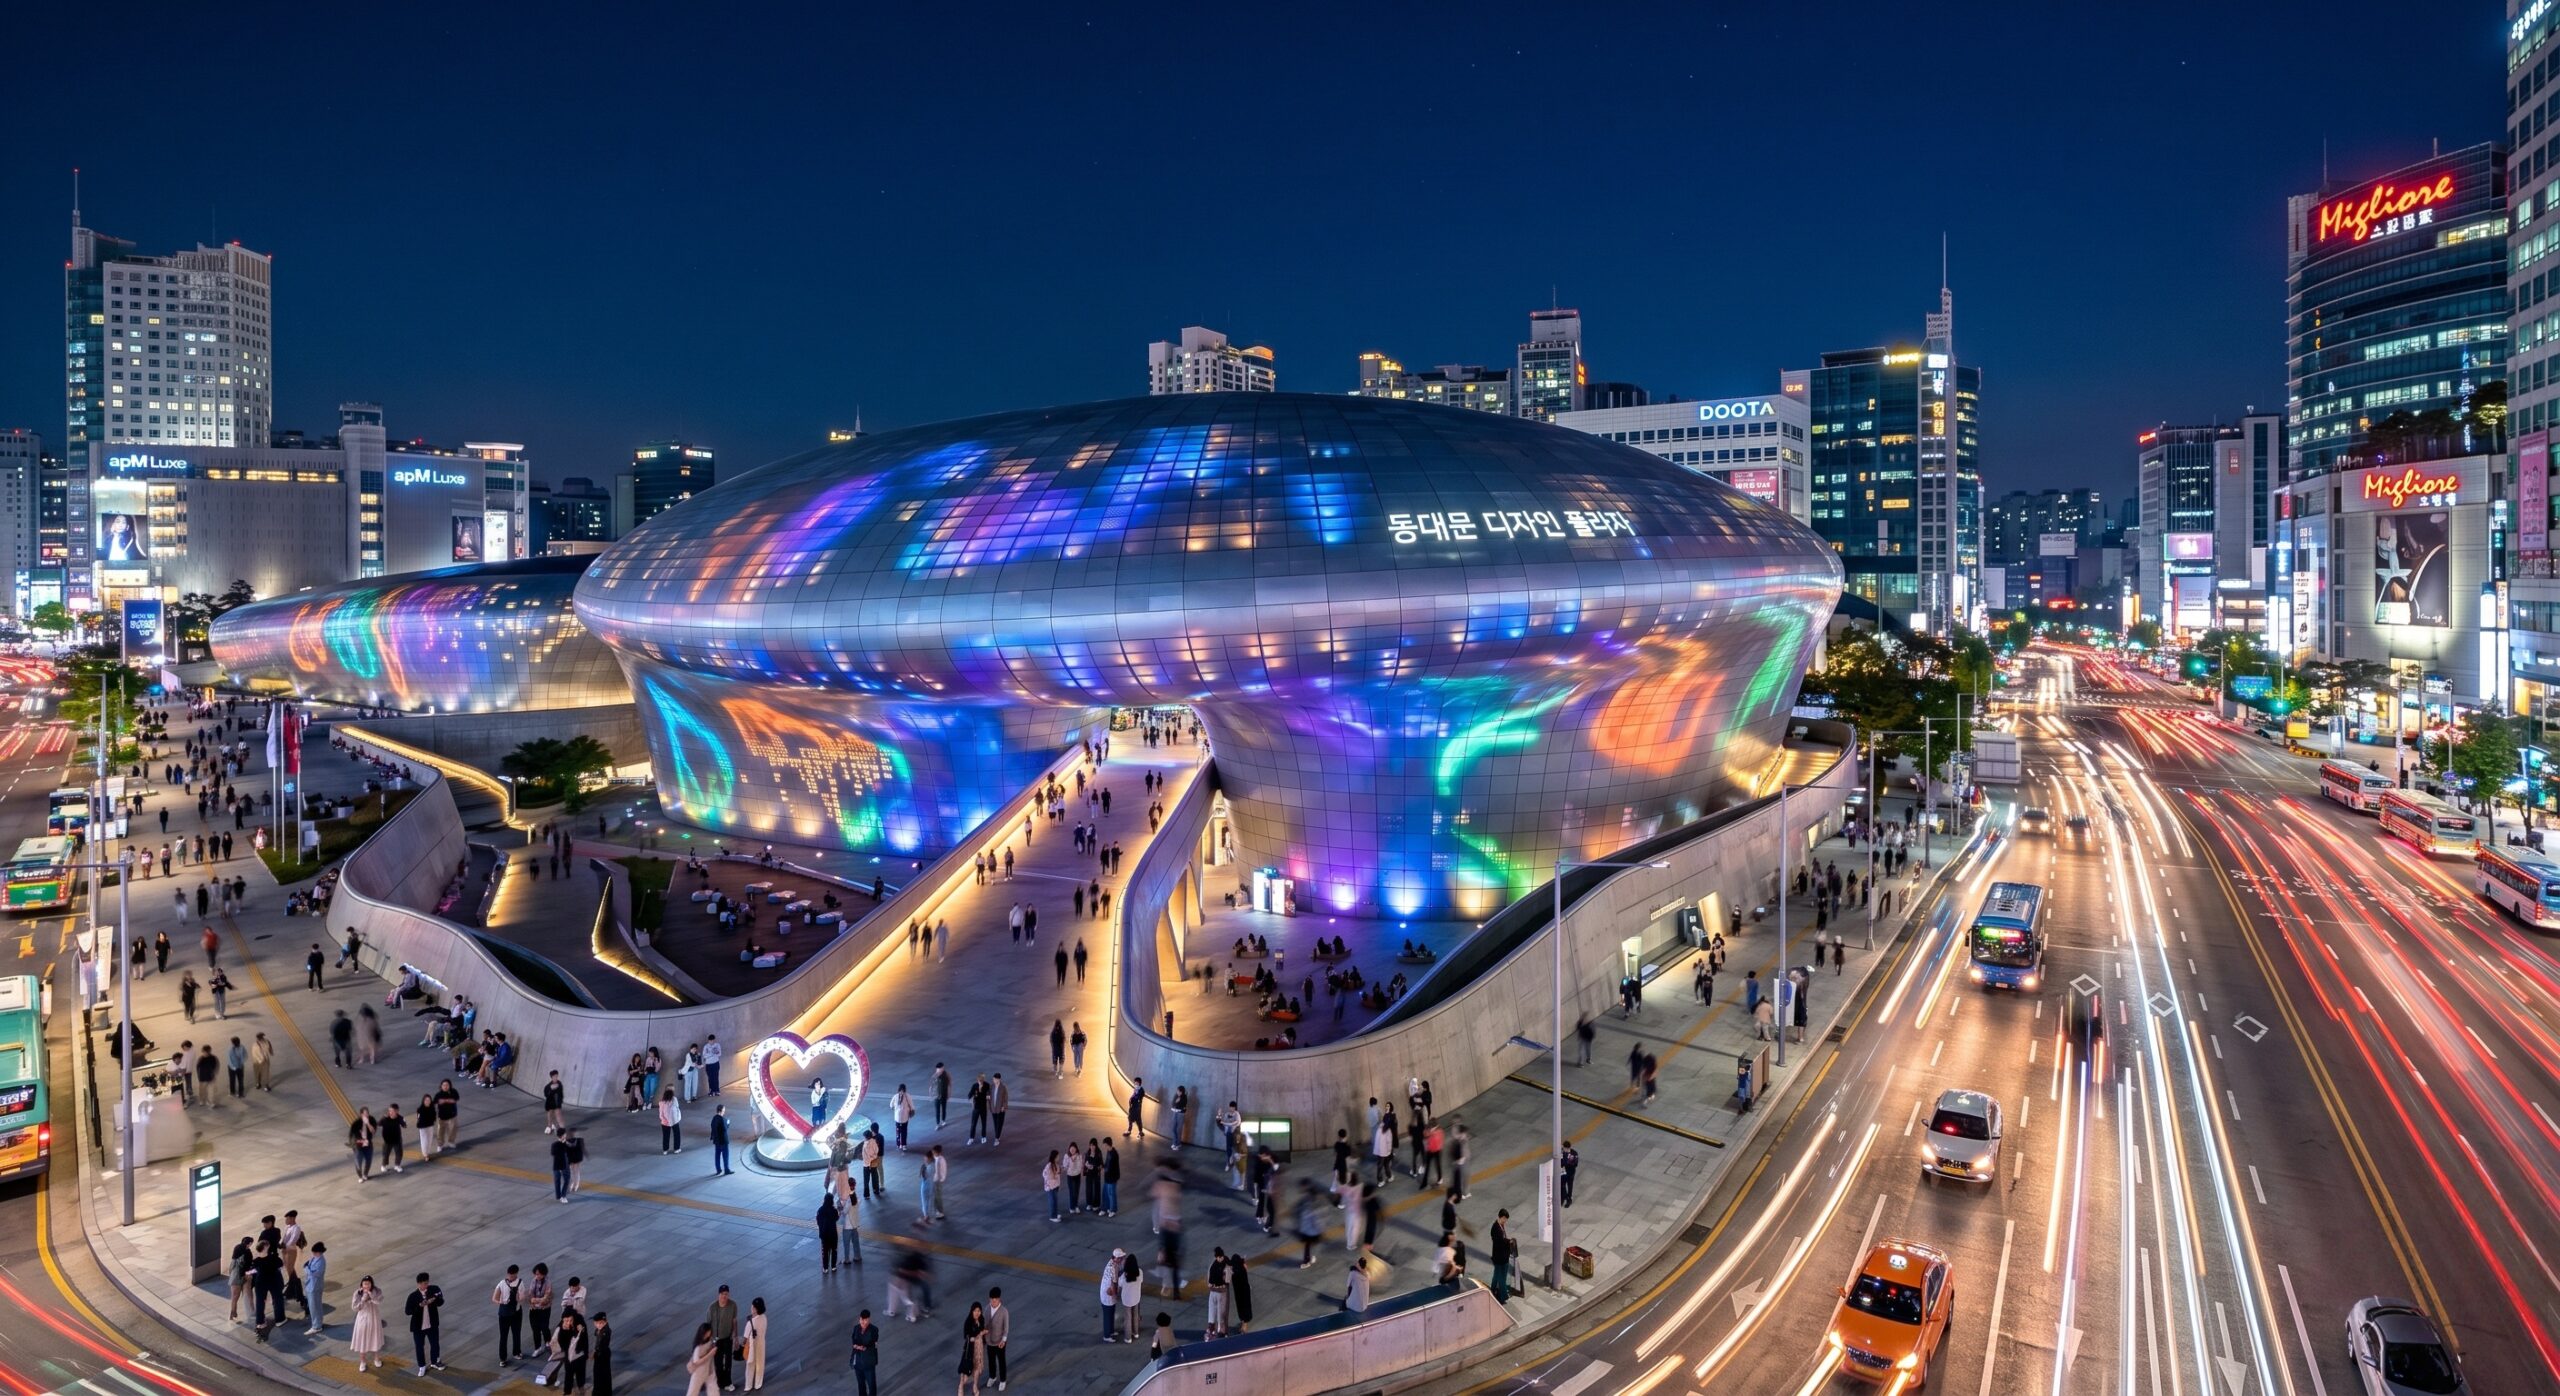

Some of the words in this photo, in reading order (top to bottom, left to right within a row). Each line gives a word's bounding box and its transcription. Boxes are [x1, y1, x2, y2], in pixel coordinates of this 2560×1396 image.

[2319, 176, 2454, 242] Migliore
[1700, 401, 1775, 420] DOOTA
[109, 454, 148, 471] apM
[150, 455, 187, 469] Luxe
[394, 468, 430, 486] apM
[2364, 468, 2458, 508] Migliore
[1387, 511, 1478, 544] 동대문
[1482, 510, 1566, 539] 디자인
[1563, 510, 1636, 538] 플라자
